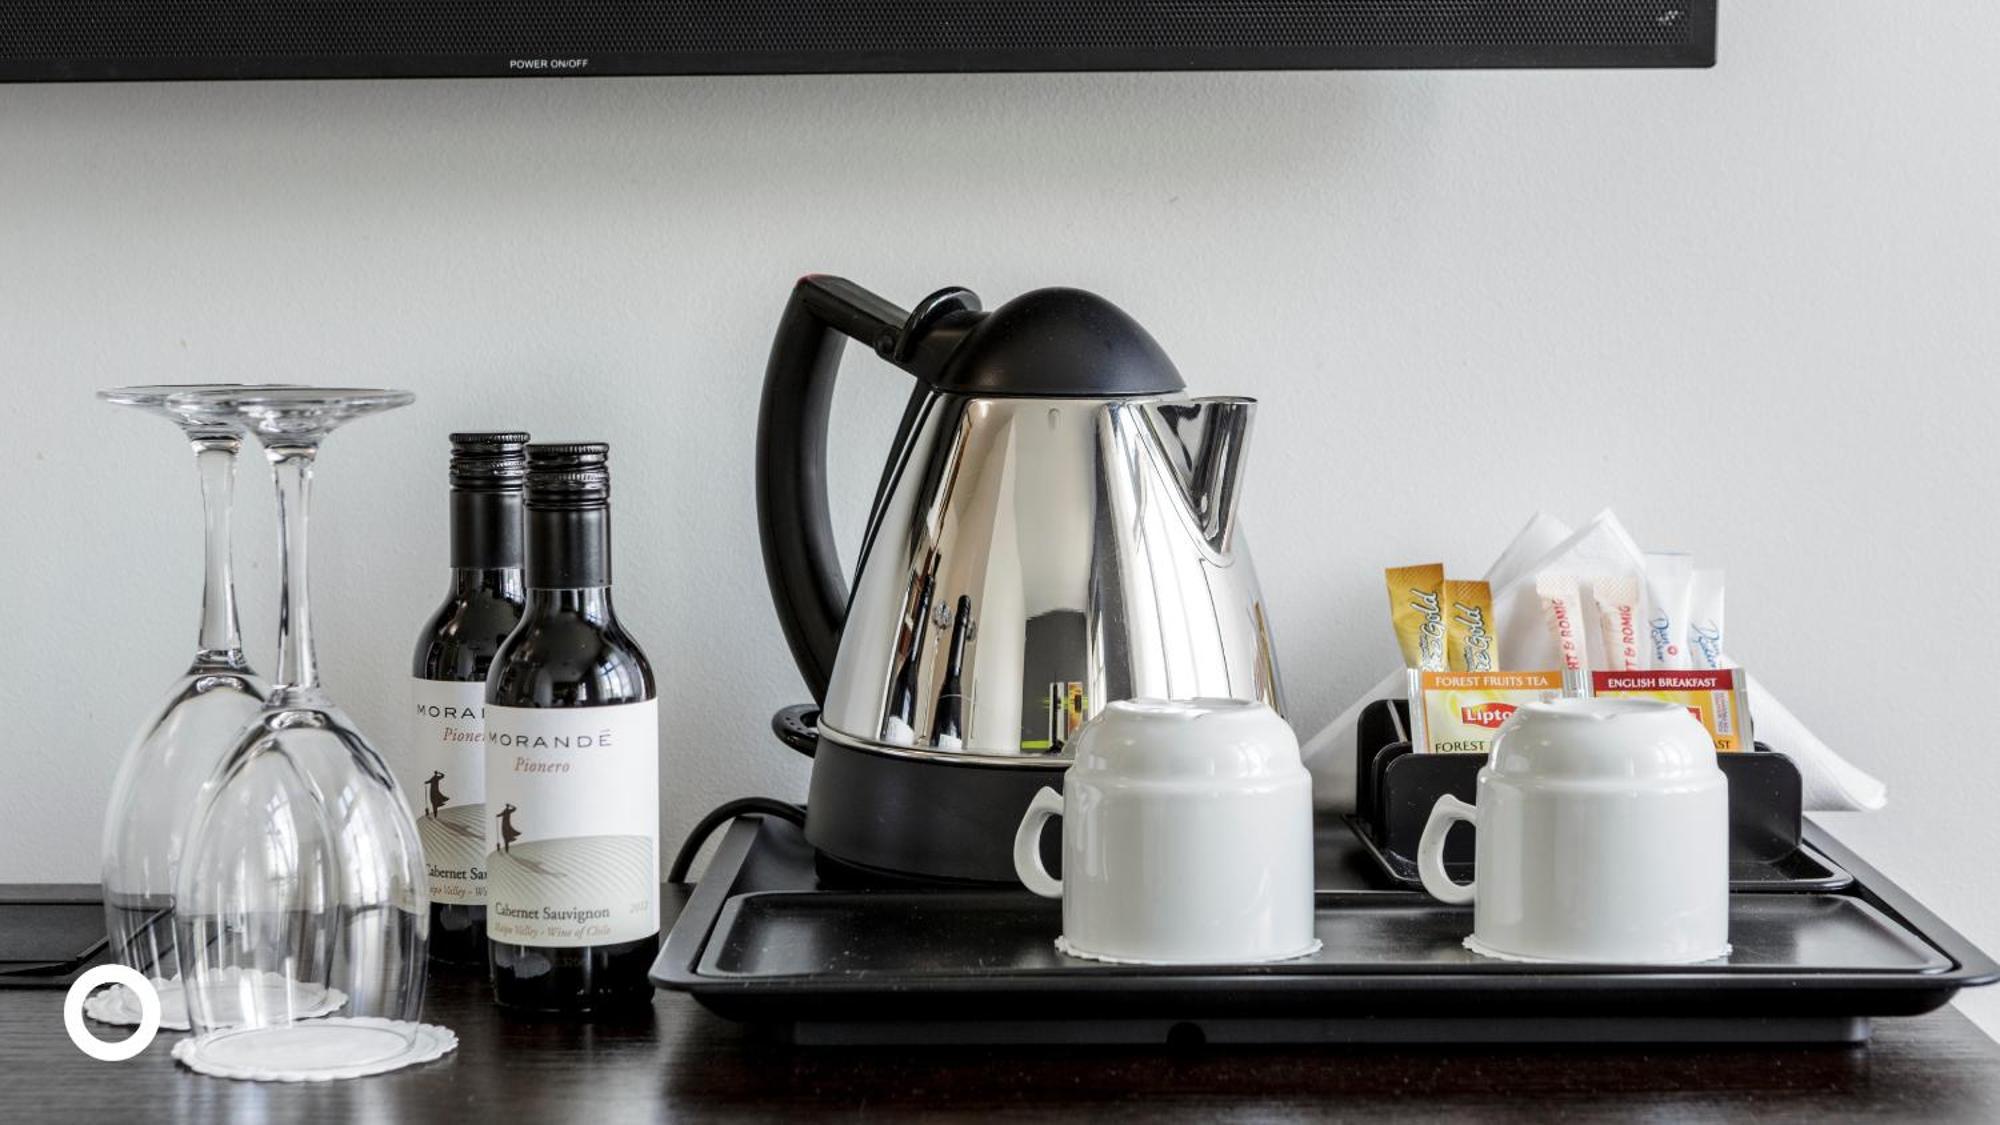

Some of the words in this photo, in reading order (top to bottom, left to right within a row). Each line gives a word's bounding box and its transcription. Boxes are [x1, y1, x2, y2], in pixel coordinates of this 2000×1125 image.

[510, 60, 548, 69] POWER
[550, 59, 589, 69] ON/OFF
[1409, 588, 1446, 637] Gold
[1453, 602, 1492, 650] Gold
[1619, 604, 1635, 644] ROMIG
[1436, 677, 1480, 687] FOREST
[1484, 676, 1522, 686] FRUITS
[1527, 676, 1548, 686] TEA
[1608, 678, 1655, 688] ENGLISH
[1658, 677, 1717, 688] BREAKFAST
[443, 727, 485, 742] Pione
[489, 729, 611, 748] MORANDÉ
[1435, 741, 1484, 753] FOREST
[514, 757, 571, 773] Pionero
[495, 901, 540, 920] Cabernet
[543, 906, 611, 925] Sauvignon
